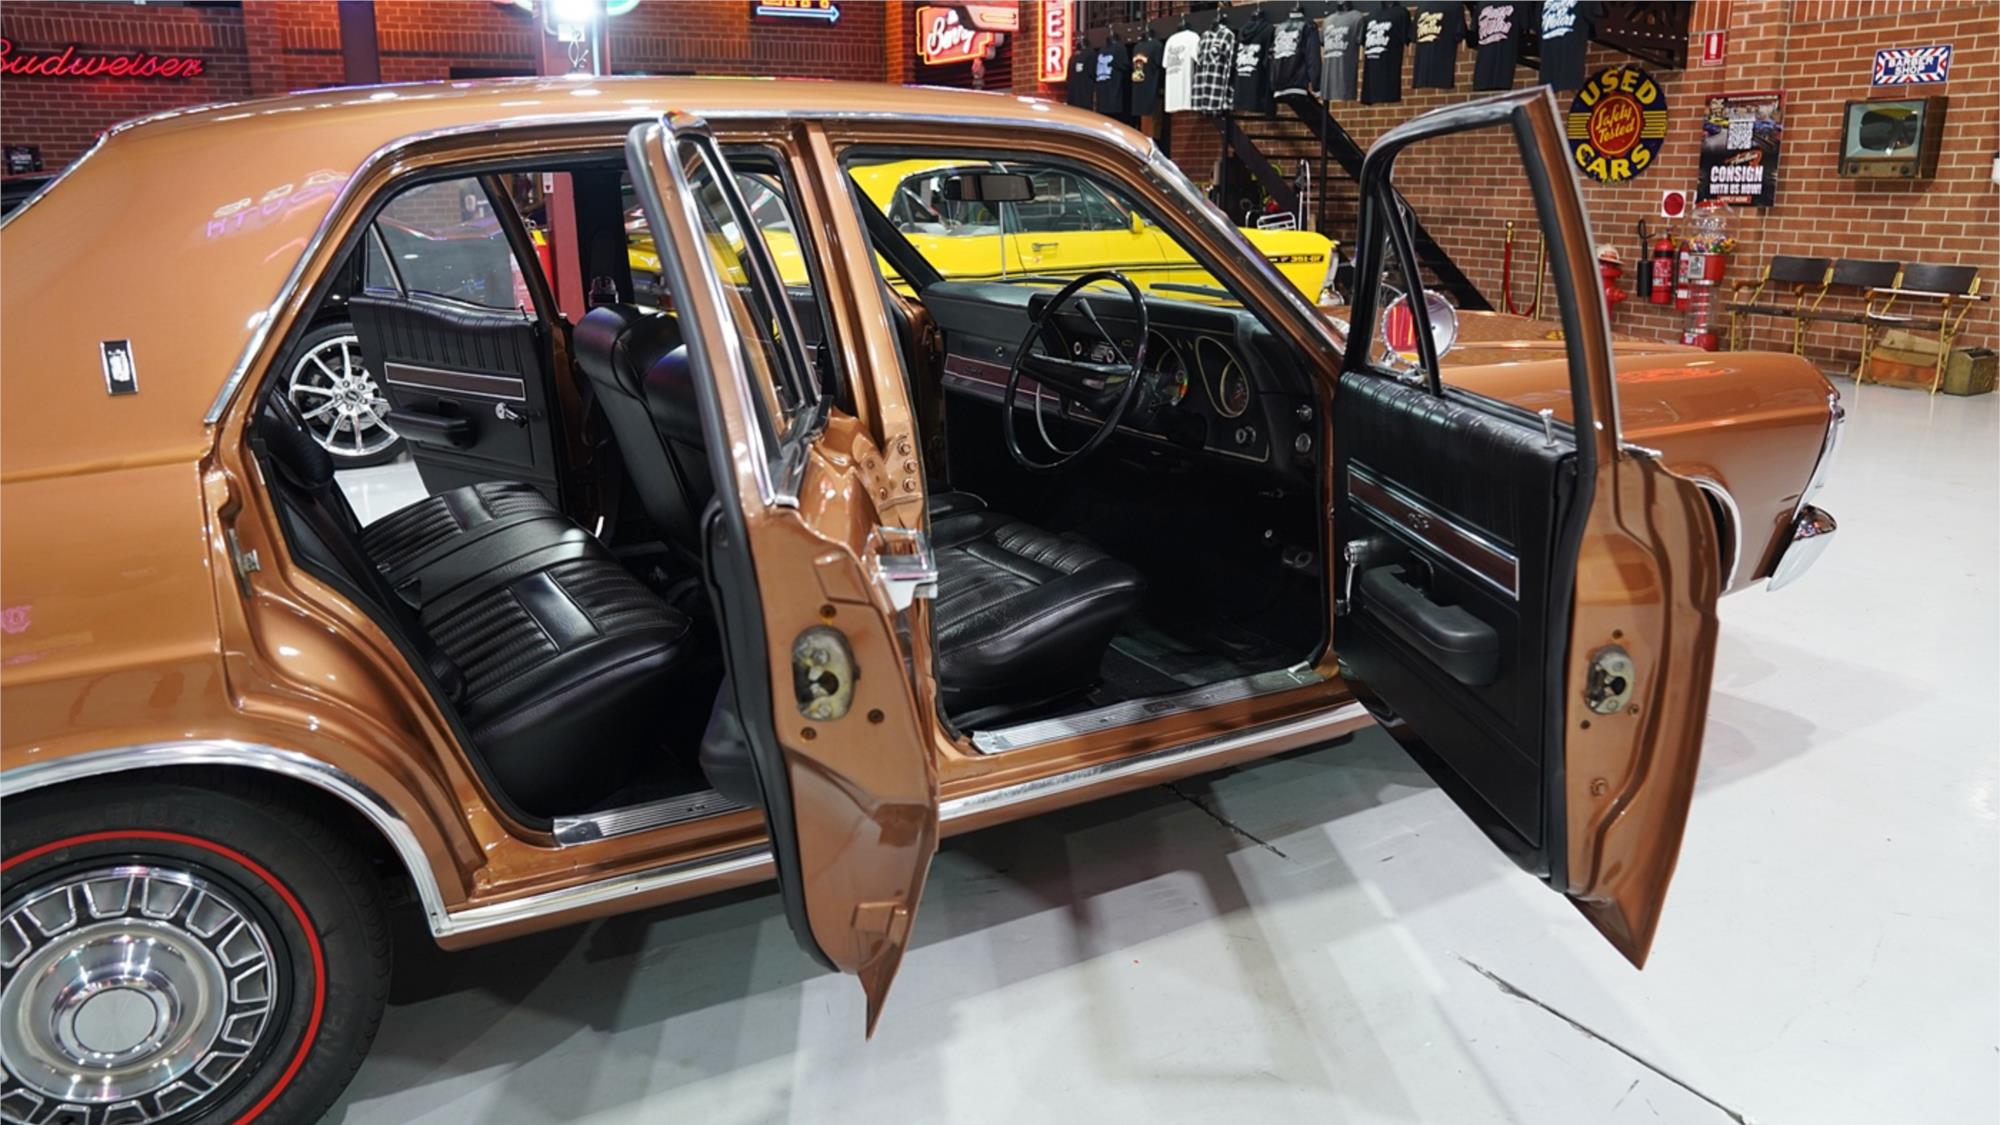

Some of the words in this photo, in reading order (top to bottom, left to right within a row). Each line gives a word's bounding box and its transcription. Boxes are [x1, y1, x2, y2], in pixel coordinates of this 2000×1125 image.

[1045, 0, 1063, 72] ER
[1888, 56, 1934, 67] BARBER
[1895, 64, 1926, 75] SHOP
[1580, 69, 1657, 106] USED
[1596, 104, 1632, 130] Safety
[1599, 118, 1635, 143] Tested
[1576, 143, 1651, 180] CARS
[1710, 165, 1763, 182] CONSIGN
[1709, 183, 1729, 194] WITH
[1730, 183, 1740, 194] US
